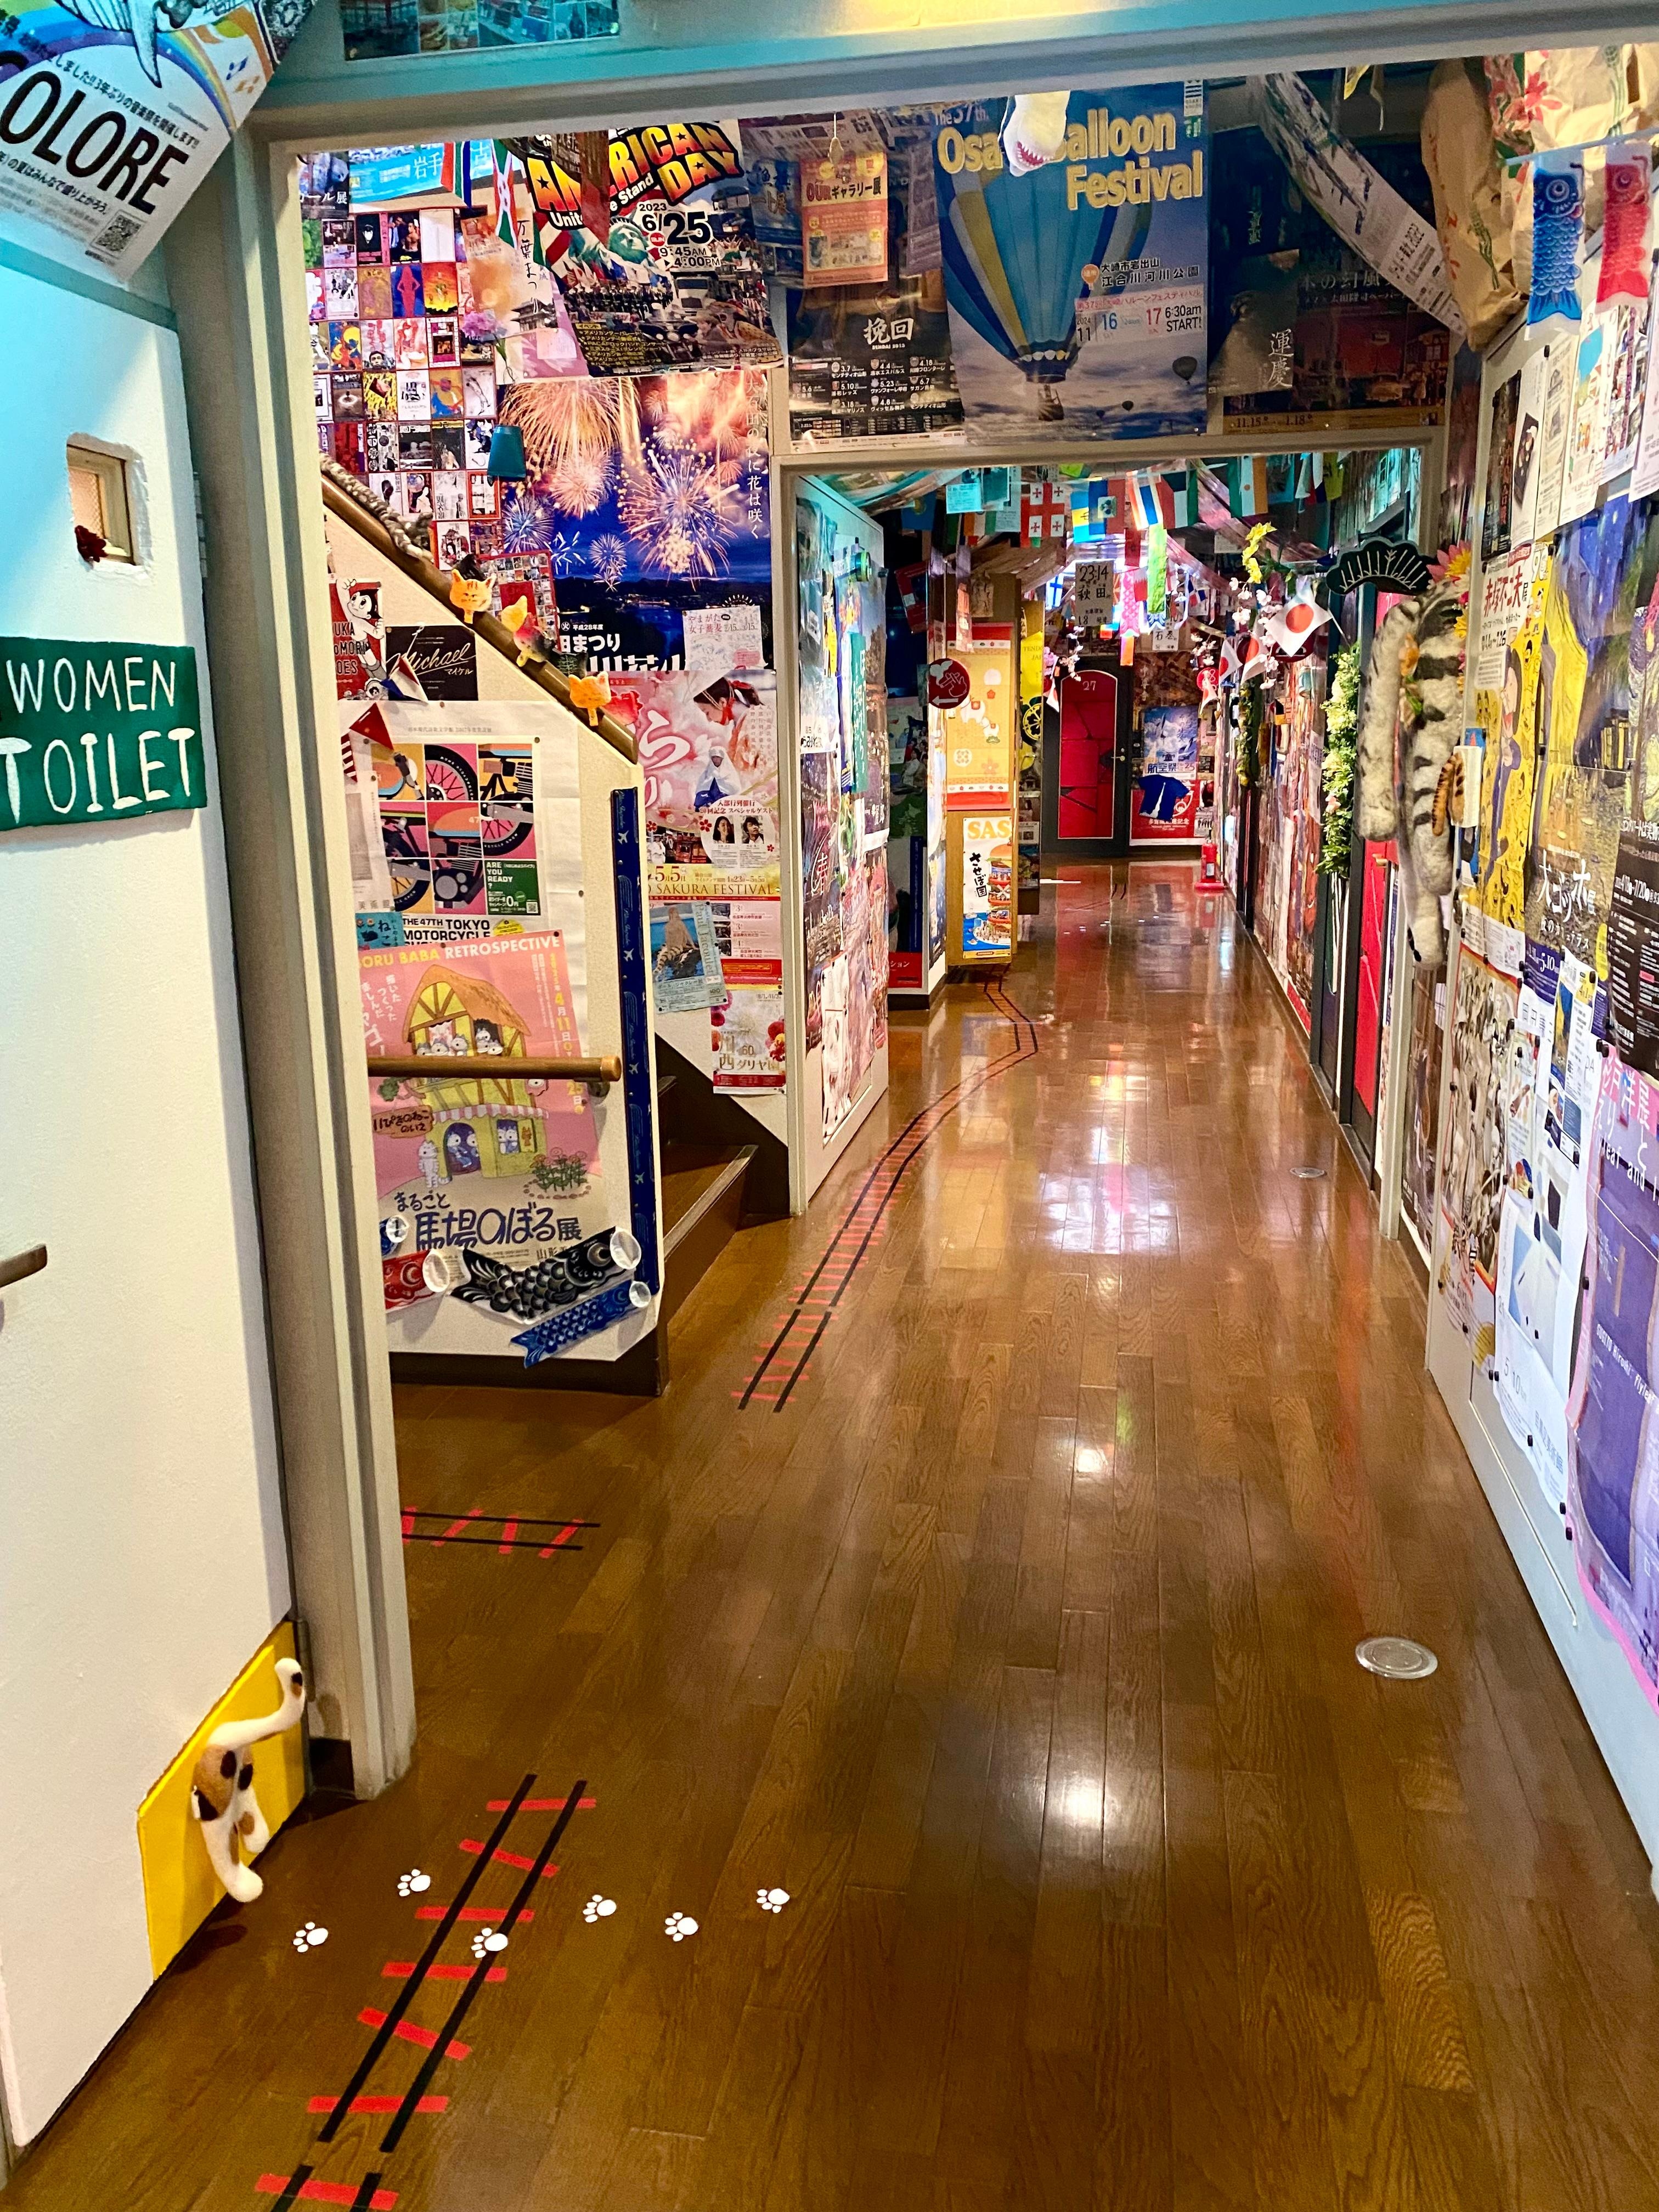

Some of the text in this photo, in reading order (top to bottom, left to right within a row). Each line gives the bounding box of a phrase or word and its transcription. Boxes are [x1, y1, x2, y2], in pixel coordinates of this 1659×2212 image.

[0, 50, 189, 215] OLORE
[938, 108, 1176, 174] Osa alloon
[527, 123, 743, 212] AMRICAN DAY
[1066, 150, 1203, 211] Festival
[550, 212, 582, 227] Unit
[618, 172, 654, 205] Stand
[639, 202, 667, 212] 2023
[642, 211, 711, 245] 6/25
[1101, 257, 1160, 273] 大崎市岩出山
[1102, 312, 1118, 330] 16
[1146, 307, 1161, 325] 17
[1165, 305, 1201, 319] 6:30am
[1166, 317, 1202, 332] START!
[863, 317, 915, 345] 挽回
[1079, 565, 1109, 582] 23:14
[1077, 586, 1106, 601] 秋田
[386, 642, 476, 678] Michael
[444, 667, 473, 675] マイケル
[6, 657, 176, 714] WOMEN
[1082, 680, 1096, 691] 27
[0, 727, 195, 824] TOILET
[656, 883, 773, 895] SAKURA FESTIVAL
[445, 919, 490, 930] TOKYO
[360, 935, 561, 968] ORU BABA RETROSPECTIVE
[1627, 1160, 1646, 1192] and
[394, 1192, 451, 1212] まるごと
